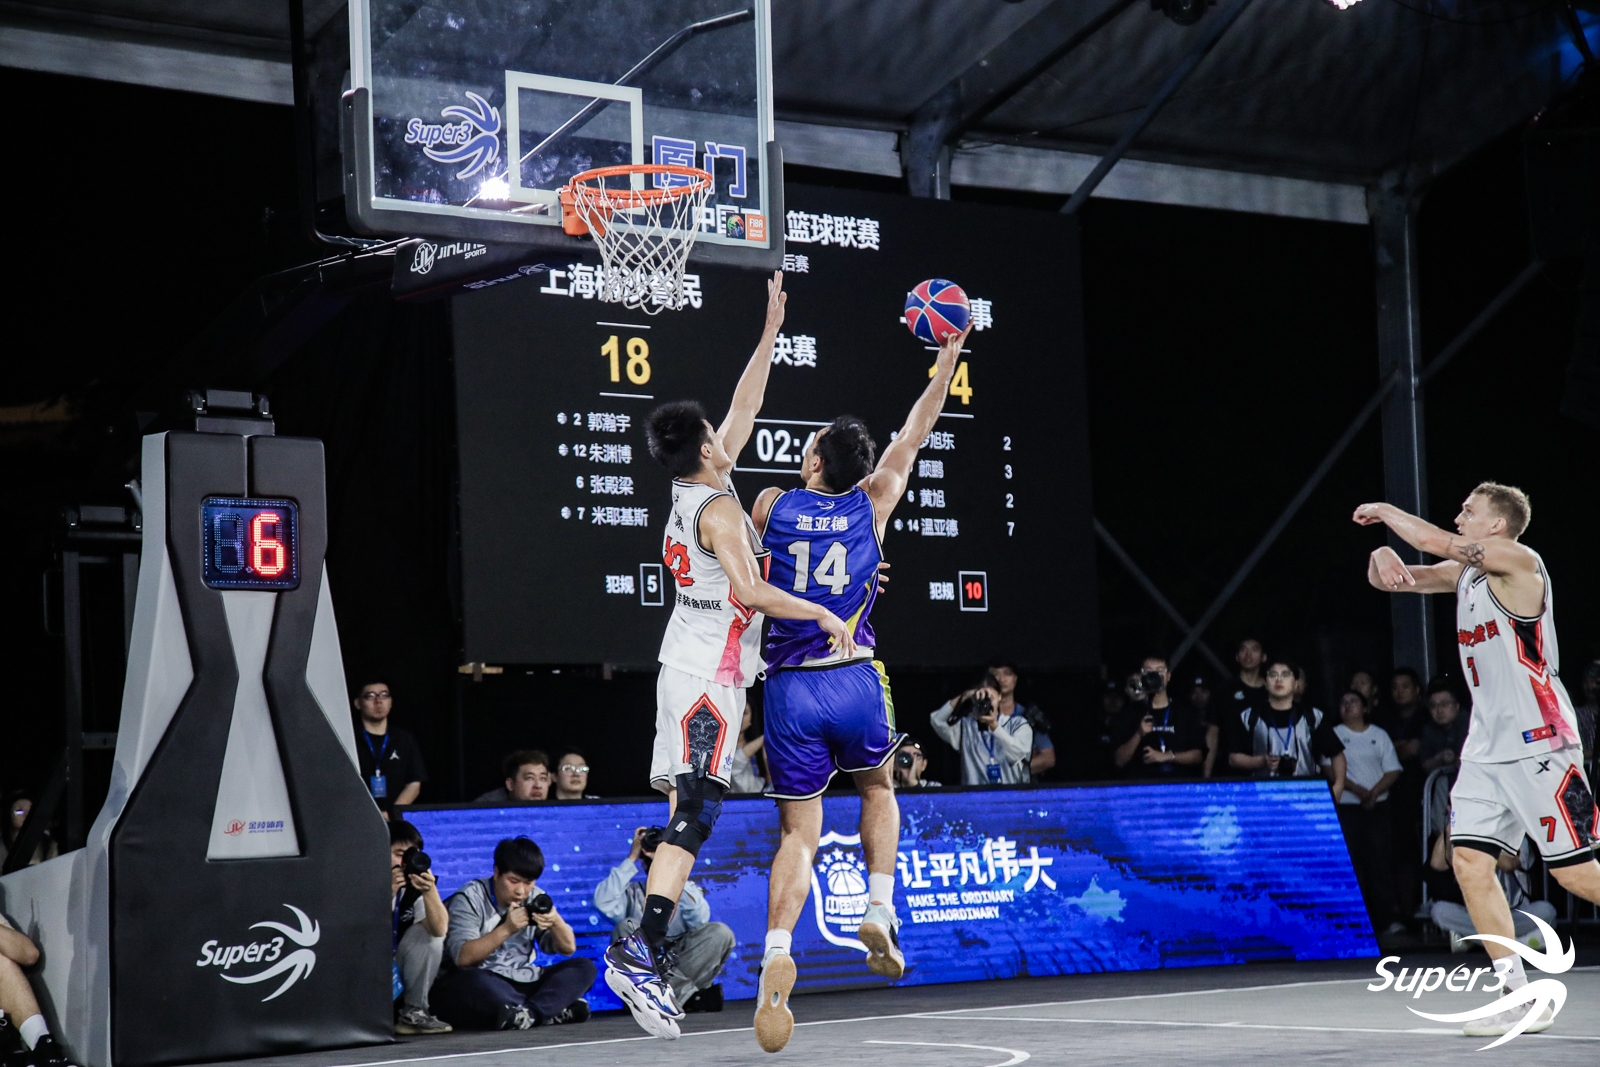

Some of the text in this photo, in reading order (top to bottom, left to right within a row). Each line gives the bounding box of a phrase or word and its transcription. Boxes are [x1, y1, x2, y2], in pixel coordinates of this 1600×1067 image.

[404, 118, 473, 148] Super3
[652, 135, 747, 198] 厦门
[749, 218, 764, 229] FIBA
[464, 247, 487, 260] SPORTS
[600, 335, 651, 385] 18
[573, 412, 582, 426] 2
[572, 444, 587, 457] 12
[1003, 436, 1012, 451] 2
[1004, 464, 1013, 479] 3
[575, 475, 584, 489] 6
[907, 488, 1014, 508] 6 黄旭 2
[577, 505, 649, 527] 7 米耶基斯
[796, 514, 849, 531] 温亚德
[907, 518, 1015, 537] 14 温亚德 7
[787, 540, 851, 596] 14
[605, 574, 658, 595] 犯规 5
[929, 581, 983, 600] 犯规 10
[1539, 816, 1557, 843] 7
[897, 836, 1056, 892] 让平凡伟大
[825, 893, 869, 916] 中国篮
[906, 889, 1014, 908] MAKE THE ORDINARY
[911, 906, 1000, 923] EXTRAORDINARY
[196, 936, 284, 969] Super3
